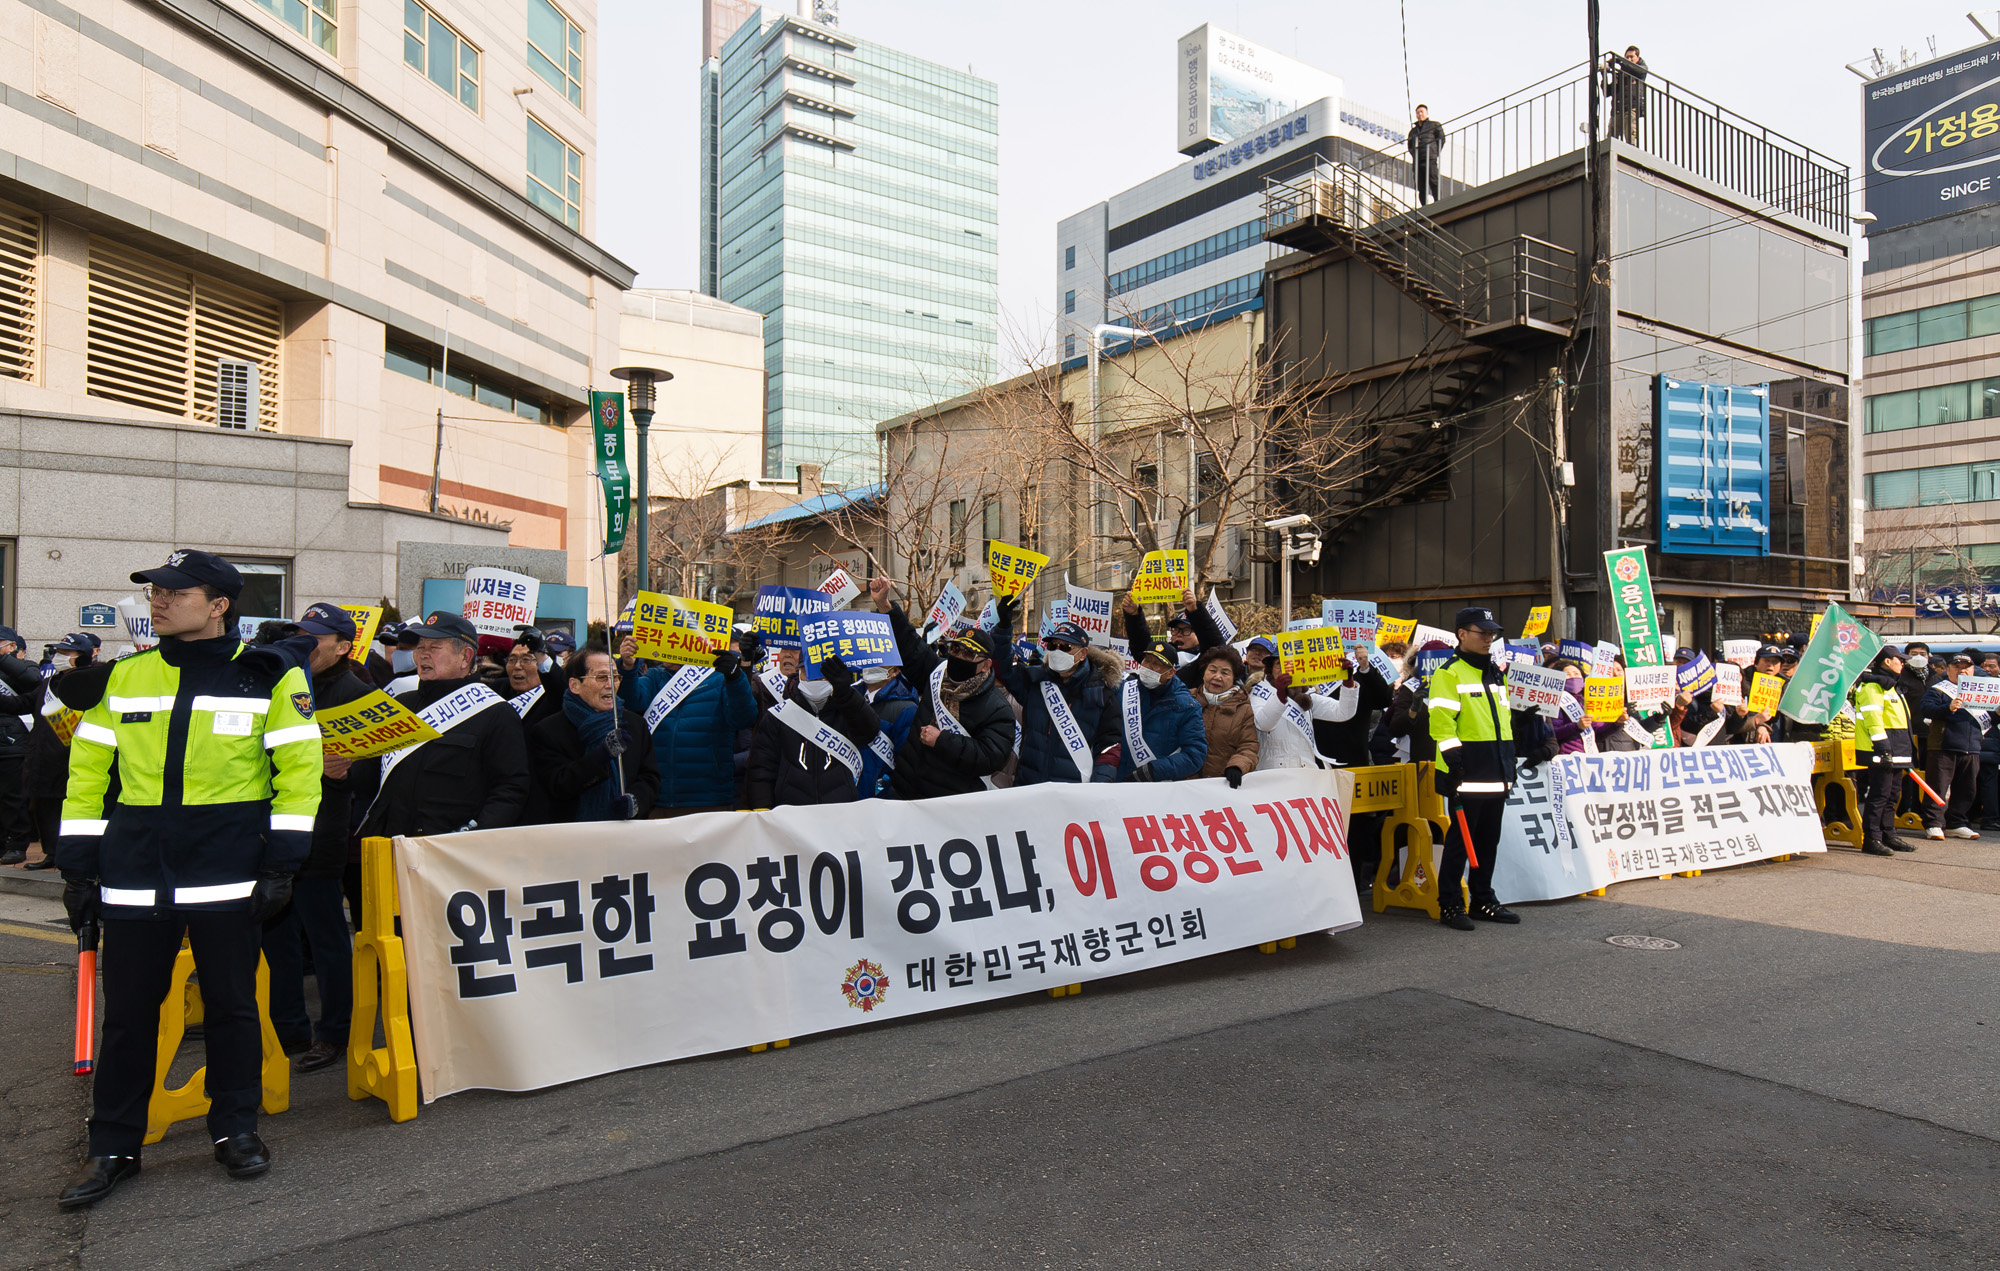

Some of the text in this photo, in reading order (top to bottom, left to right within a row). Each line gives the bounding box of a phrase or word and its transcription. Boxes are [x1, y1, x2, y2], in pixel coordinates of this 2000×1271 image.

[1872, 70, 1943, 100] 한국능률협회컨설팅
[1946, 55, 1989, 76] 브랜드파워
[1188, 57, 1198, 137] 행정공제회
[1904, 103, 2000, 154] 가정용
[1193, 114, 1309, 181] 대한지방행정공제회
[1940, 177, 1991, 201] SINCE
[992, 551, 1037, 579] 언론 갑질
[1145, 558, 1185, 574] 갑질 횡포
[465, 577, 526, 602] 시사저널은
[990, 570, 1006, 591] 즉각
[1144, 576, 1186, 592] 수사하라!
[482, 600, 533, 624] 중단하라!
[757, 594, 830, 616] 사이비 시사저널
[1073, 596, 1109, 616] 시사저널
[93, 614, 104, 624] 8
[640, 602, 668, 625] 언론
[672, 608, 700, 630] 갑질
[704, 613, 728, 635] 횡포
[751, 615, 782, 636] 강력히
[1327, 609, 1344, 624] 3류
[1349, 609, 1365, 624] 소설
[1386, 622, 1400, 633] 갑질
[636, 626, 663, 647] 즉각
[802, 619, 891, 642] 향군은 청와대와
[808, 641, 836, 664] 밥도
[839, 638, 854, 656] 못
[1282, 635, 1340, 657] 언론 갑질 횡포
[1561, 645, 1580, 659] 사이비
[1284, 657, 1305, 675] 즉각
[1634, 672, 1669, 686] 시사저널은
[1961, 680, 1984, 693] 한글도
[1589, 684, 1606, 697] 언론
[1958, 692, 1973, 704] 기자
[1975, 692, 1988, 704] 즉각
[326, 714, 368, 735] 갑질
[358, 700, 401, 724] 횡포
[1587, 700, 1603, 713] 즉각
[350, 715, 422, 750] 수사하라!
[1660, 745, 1786, 789] 안보단체로서
[1369, 779, 1398, 797] LINE
[1584, 796, 1685, 844] 안보정책을
[1690, 790, 1749, 829] 적극
[1621, 834, 1763, 873] 대한민국재향군인회
[446, 872, 656, 1000] 완곡한
[684, 850, 865, 961] 요청이
[886, 830, 1056, 935] 강요냐,
[1063, 820, 1119, 900] 이
[1122, 806, 1264, 893] 멍청한
[907, 907, 1208, 994] 대한민국재향군인회
